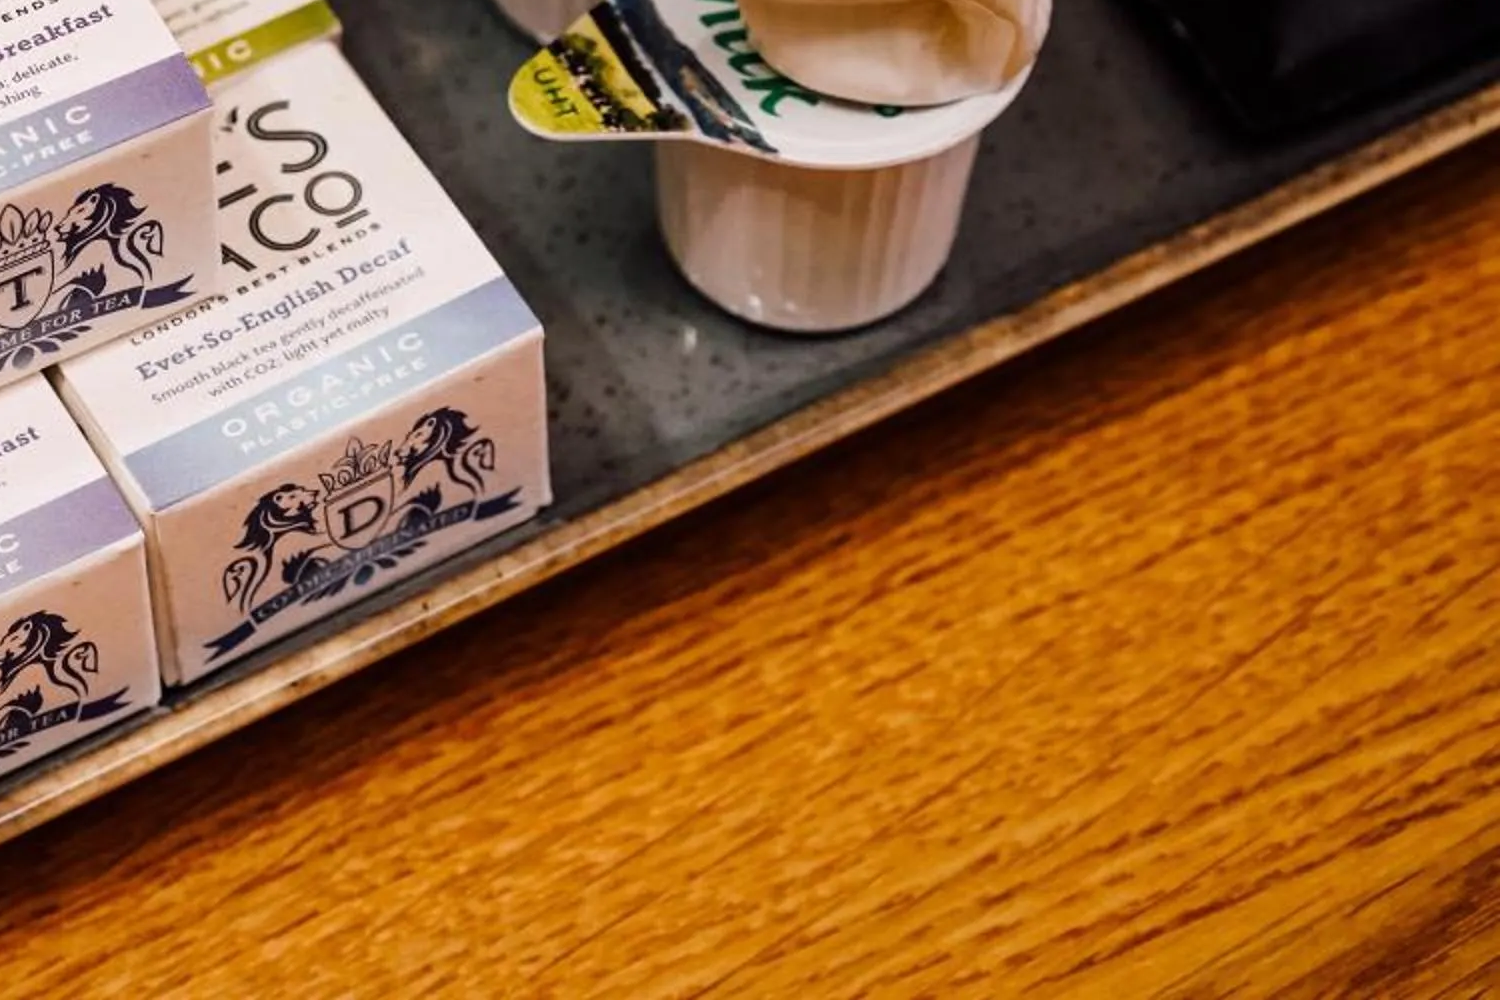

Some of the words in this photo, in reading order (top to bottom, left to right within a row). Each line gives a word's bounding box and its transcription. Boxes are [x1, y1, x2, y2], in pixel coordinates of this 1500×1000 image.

[532, 66, 578, 118] UHT
[40, 308, 84, 337] FOR
[90, 292, 133, 317] TEA
[130, 293, 230, 347] LONDON'S
[237, 263, 291, 295] BEST
[299, 222, 382, 266] BLENDS
[135, 276, 336, 383] Ever-So-English
[336, 237, 413, 287] Decaf
[151, 370, 210, 404] Smooth
[210, 350, 250, 378] black
[252, 339, 278, 360] tea
[279, 313, 327, 350] gently
[327, 266, 426, 325] decaffeinated
[207, 374, 244, 398] with
[283, 337, 320, 365] light
[322, 326, 347, 348] yet
[348, 305, 391, 335] malty
[221, 332, 424, 439] ORGANIC
[240, 356, 428, 455] PLASTIC-FREE
[337, 496, 384, 540] D
[30, 709, 69, 732] TEA
